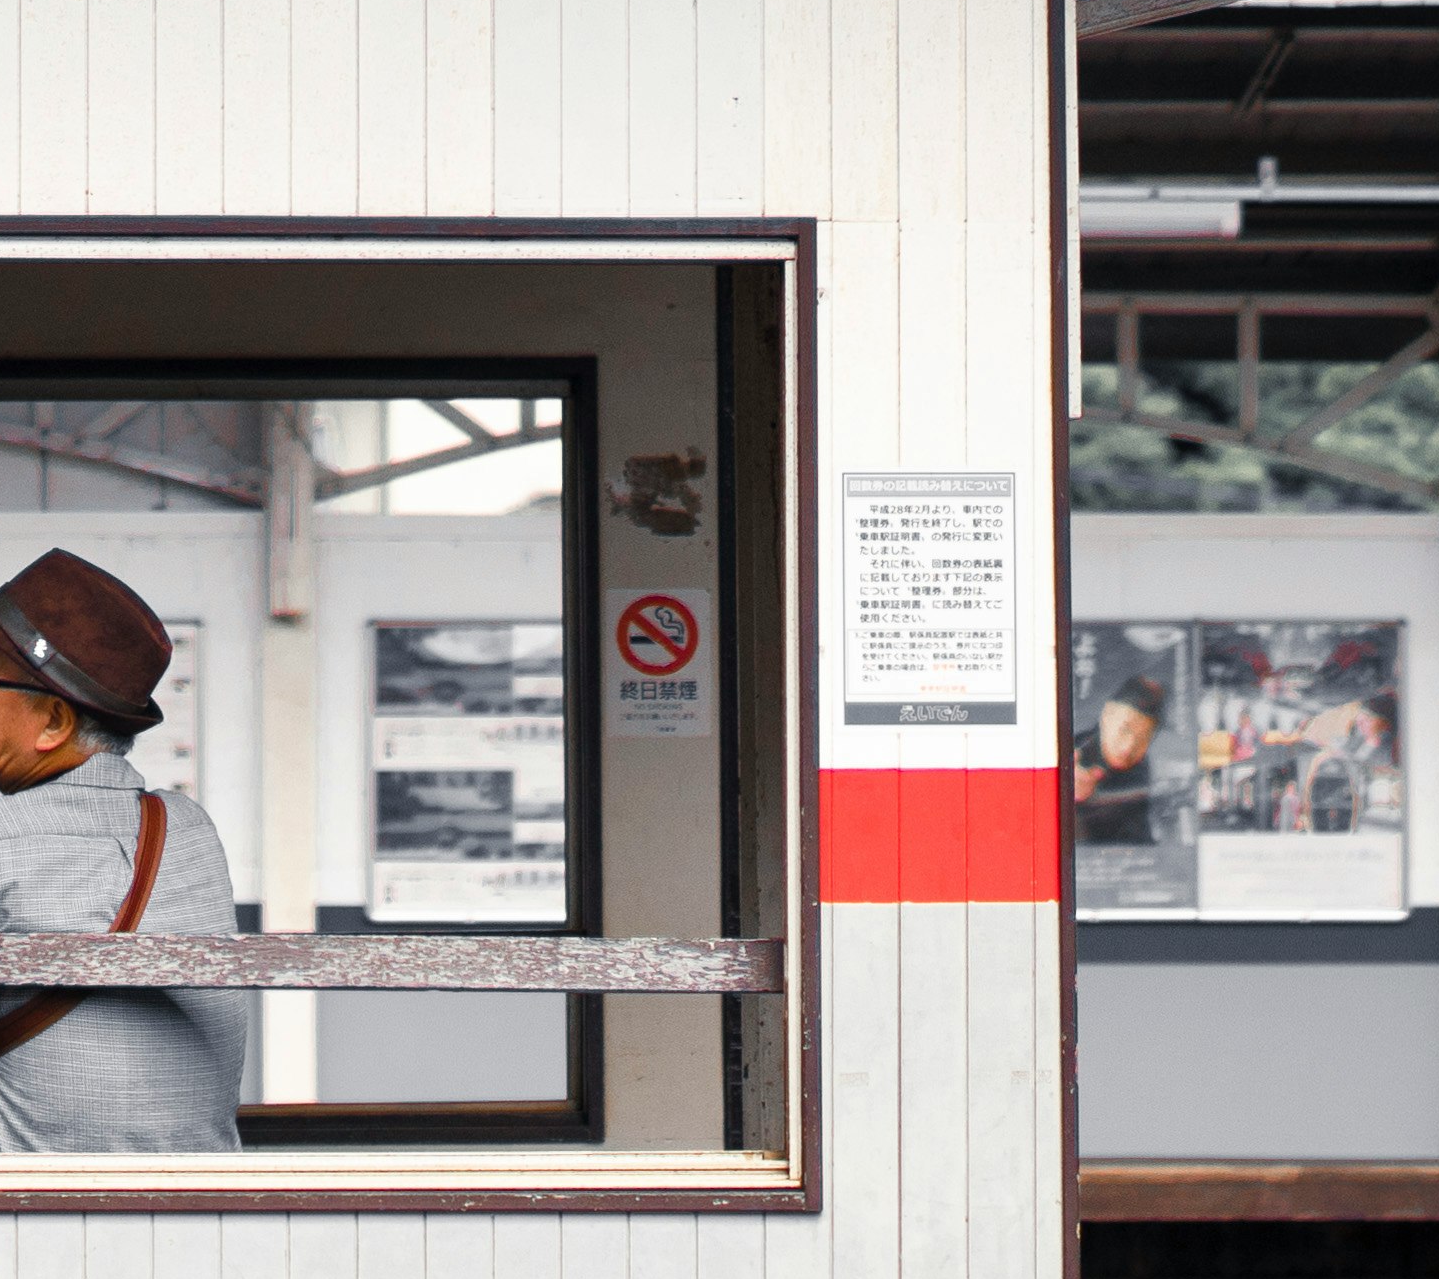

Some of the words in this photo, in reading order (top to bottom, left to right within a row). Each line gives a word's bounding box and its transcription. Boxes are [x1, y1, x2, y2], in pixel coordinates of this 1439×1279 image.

[860, 546, 915, 555] たしました。
[620, 680, 697, 700] 終日禁煙
[899, 705, 968, 722] えいでん
